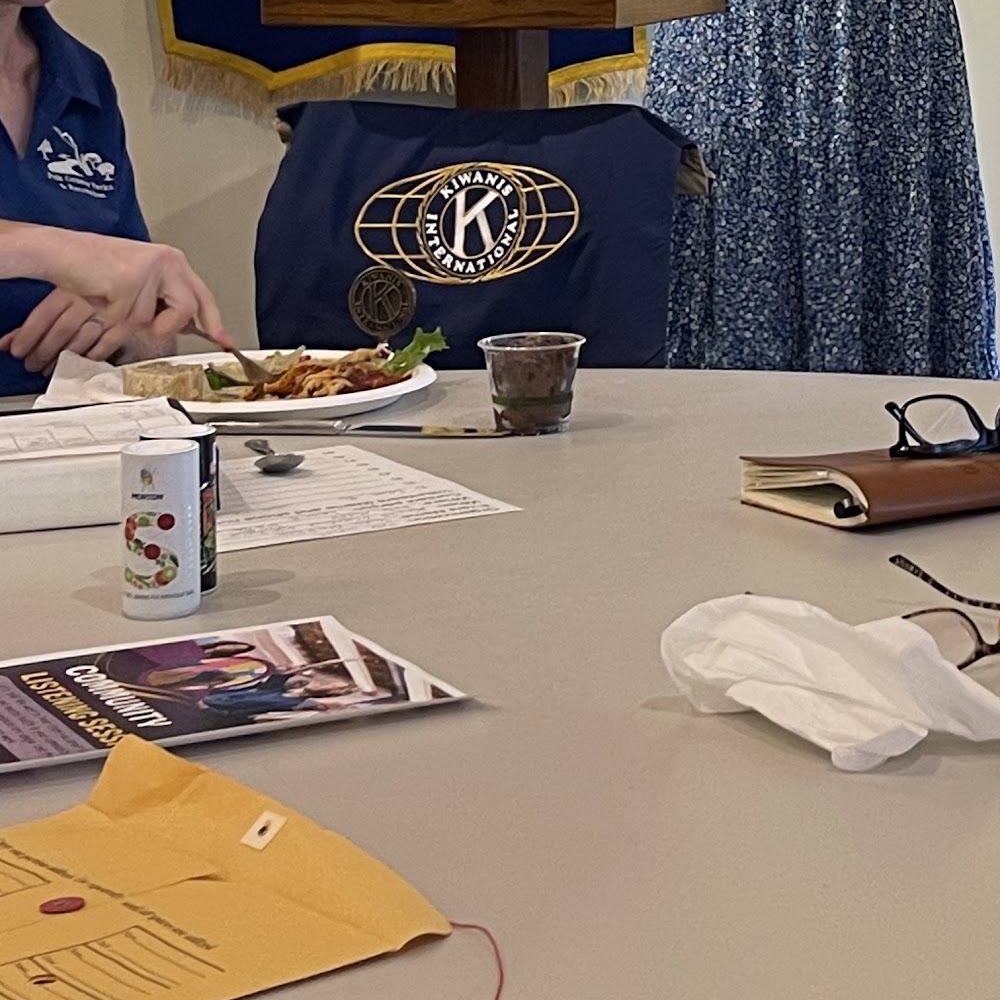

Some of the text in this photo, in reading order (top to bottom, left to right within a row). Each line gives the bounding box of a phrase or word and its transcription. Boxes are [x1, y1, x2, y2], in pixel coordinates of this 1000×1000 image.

[439, 170, 514, 200] KIWANIS
[425, 208, 518, 274] INTERNATIONAL
[452, 189, 501, 258] K
[20, 671, 99, 720] LISTENING
[65, 665, 173, 728] COMMUNITY
